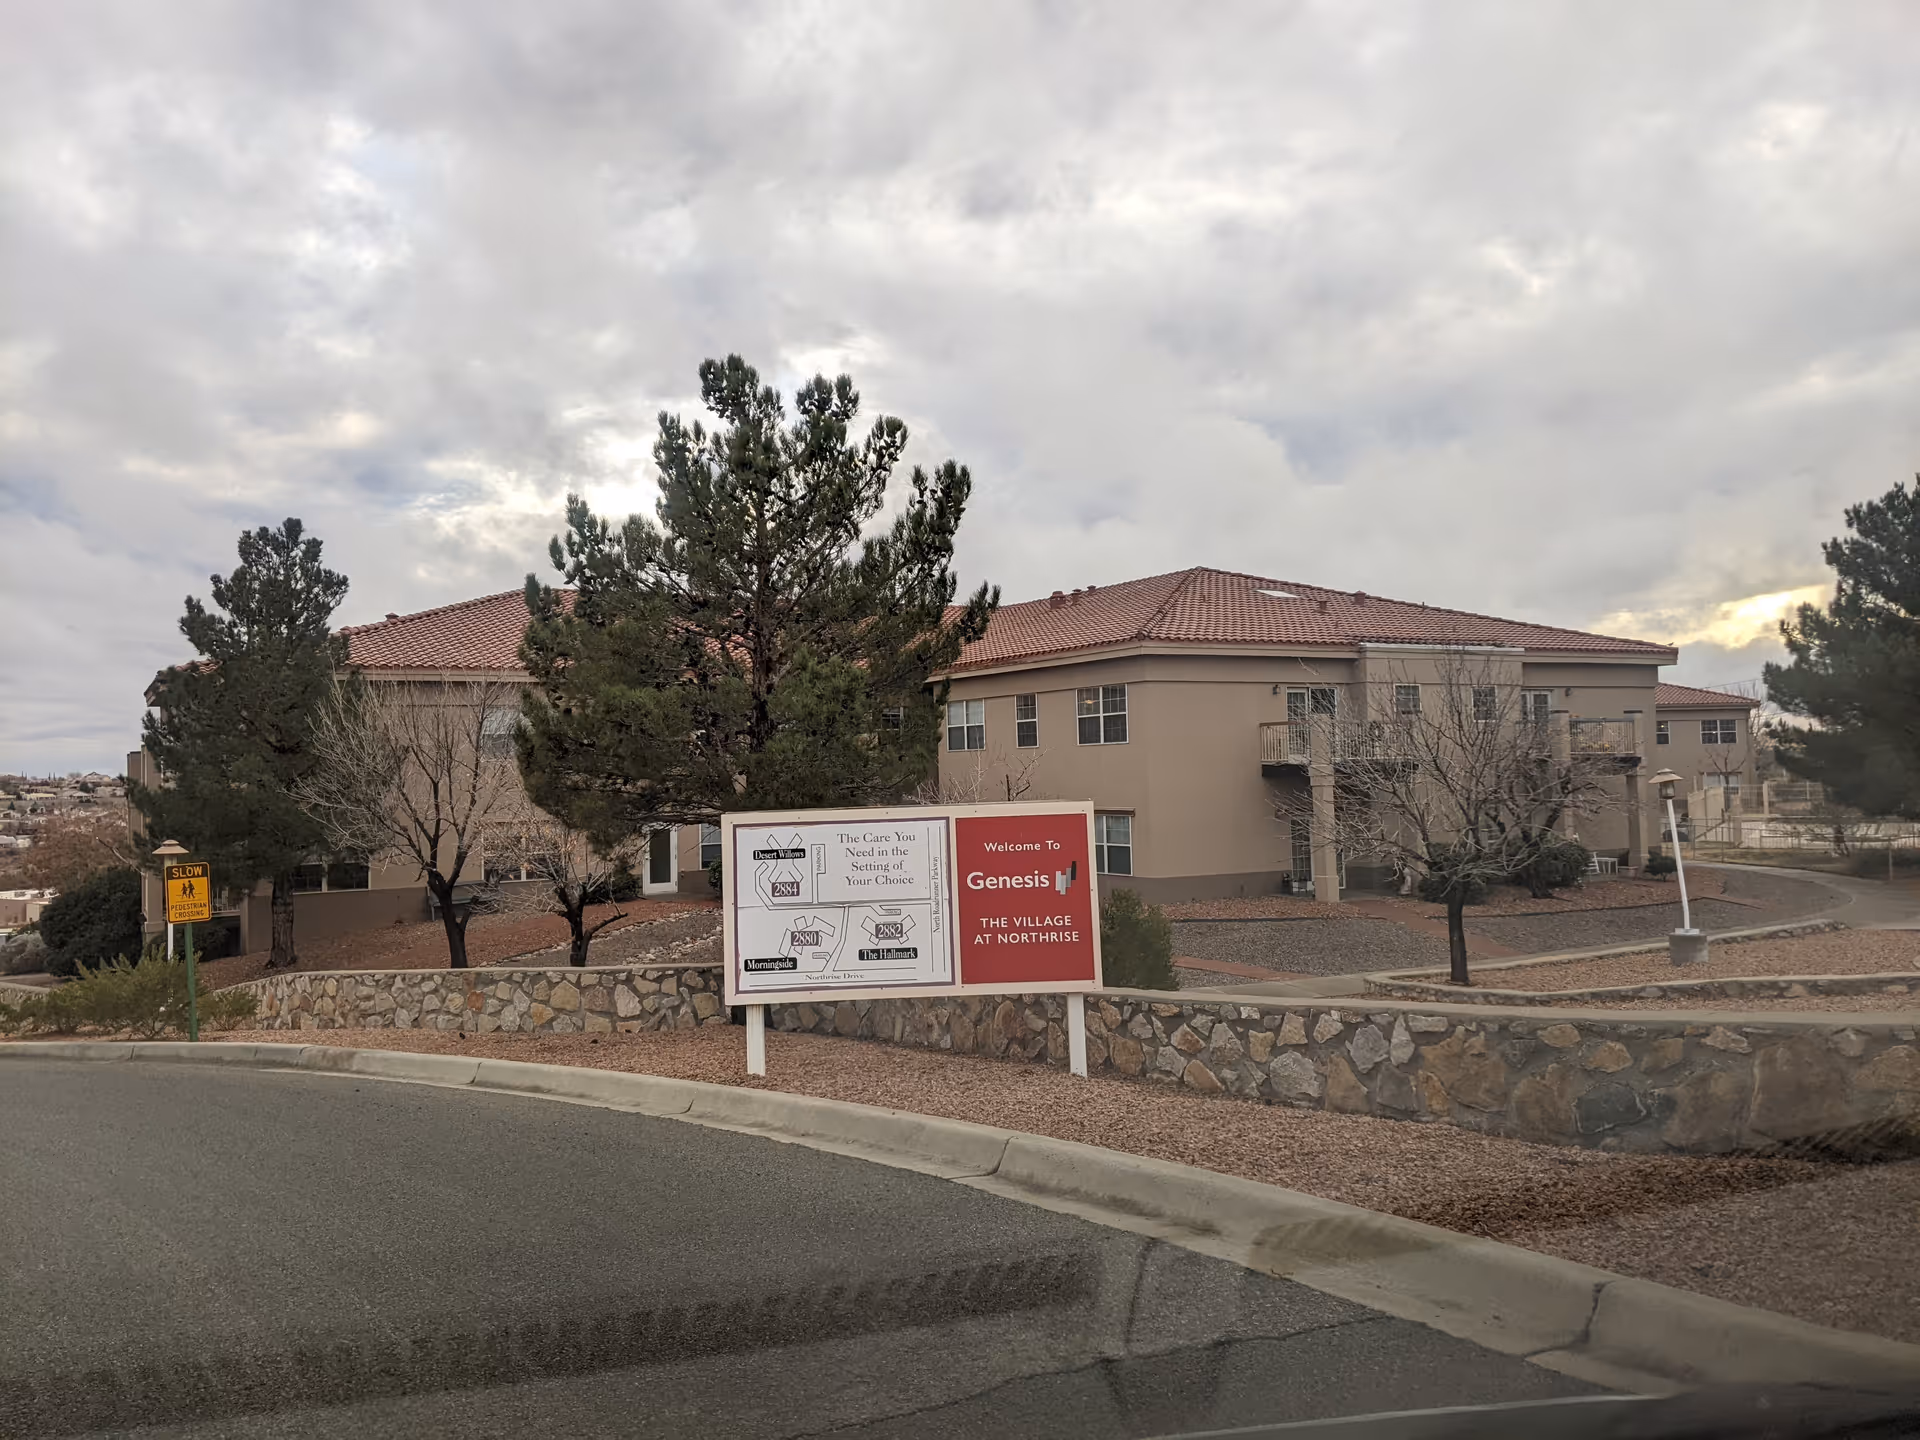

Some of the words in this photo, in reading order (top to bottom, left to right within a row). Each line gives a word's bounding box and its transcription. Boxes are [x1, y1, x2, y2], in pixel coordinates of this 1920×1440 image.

[837, 833, 860, 843] The
[863, 832, 891, 842] Care
[894, 831, 916, 842] You
[845, 847, 875, 858] Need
[878, 847, 888, 856] in
[891, 846, 908, 856] the
[984, 842, 1041, 852] Welcome
[1046, 840, 1061, 849] To
[755, 850, 777, 859] Desert
[778, 850, 804, 859] Willows
[172, 866, 202, 877] SLOW
[851, 862, 889, 873] Setting
[893, 860, 904, 870] of
[931, 856, 939, 880] Parkway
[845, 876, 872, 886] Your
[875, 874, 914, 885] Choice
[967, 870, 1050, 890] Genesis
[774, 883, 798, 896] 2884
[171, 902, 207, 911] PEDESTRIAN
[175, 910, 204, 918] CROSSING
[980, 918, 1008, 928] THE
[1013, 916, 1072, 927] VILLAGE
[878, 925, 901, 938] 2882
[793, 932, 816, 944] 2880
[974, 934, 992, 944] AT
[998, 932, 1079, 943] NORTHRISE
[862, 950, 877, 960] The
[879, 949, 916, 959] Hallmark
[747, 959, 793, 971] Morningside
